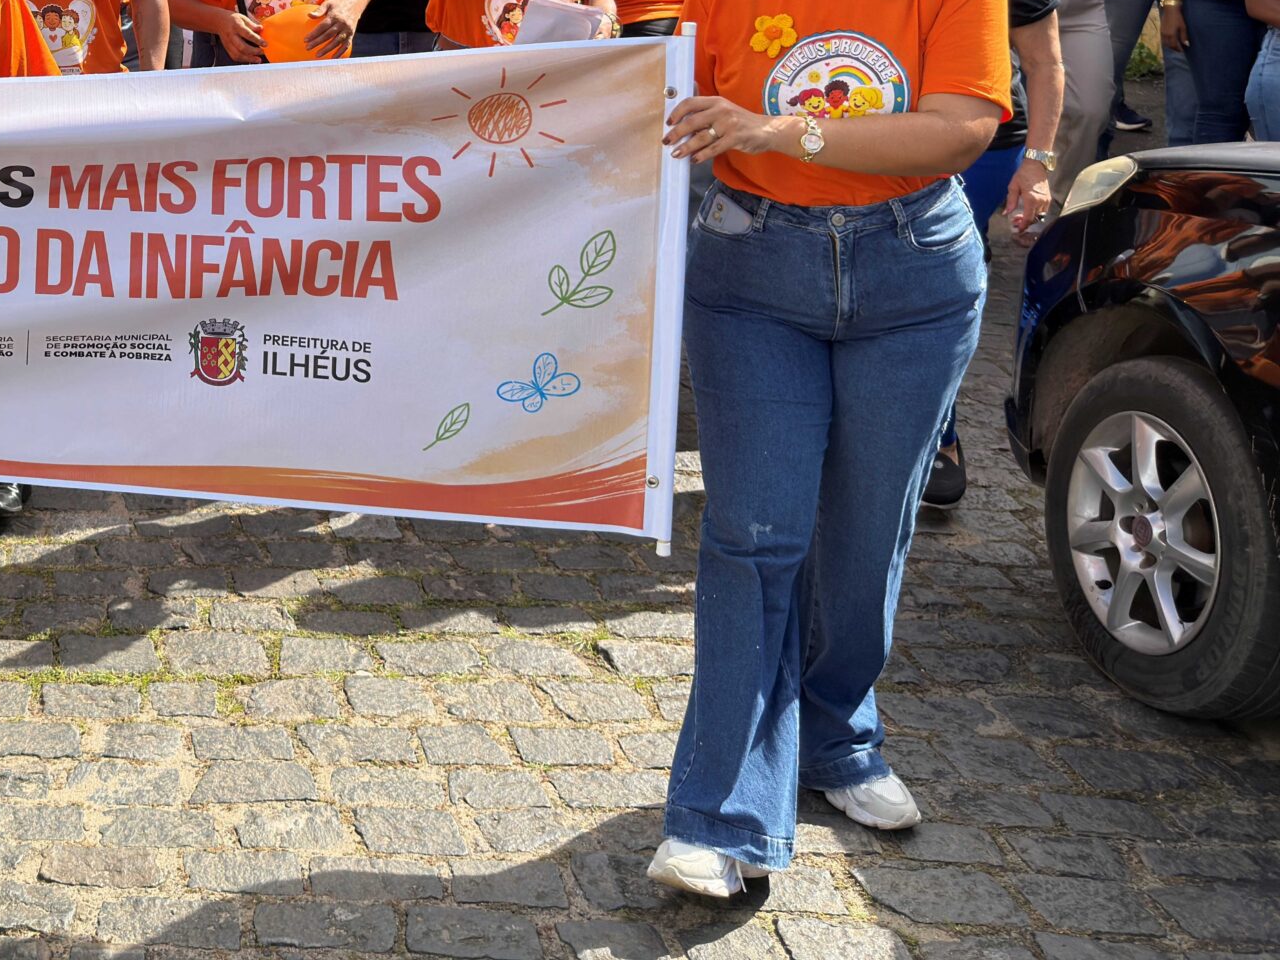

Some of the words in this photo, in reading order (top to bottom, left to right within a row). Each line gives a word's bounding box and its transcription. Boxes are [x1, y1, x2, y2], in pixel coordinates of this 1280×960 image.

[831, 39, 898, 81] PROTEGE
[48, 160, 197, 215] MAIS
[211, 154, 442, 223] FORTES
[35, 228, 115, 298] DA
[128, 220, 399, 301] INFÂNCIA
[63, 341, 127, 351] PROMOÇÃO
[130, 342, 171, 351] SOCIAL
[117, 333, 173, 342] MUNICIPAL
[263, 334, 349, 353] PREFEITURA
[352, 341, 372, 354] DE
[44, 350, 51, 358] E
[53, 350, 106, 359] COMBATE
[108, 349, 117, 359] À
[119, 351, 173, 362] POBREZA
[262, 349, 372, 384] ILHÉUS
